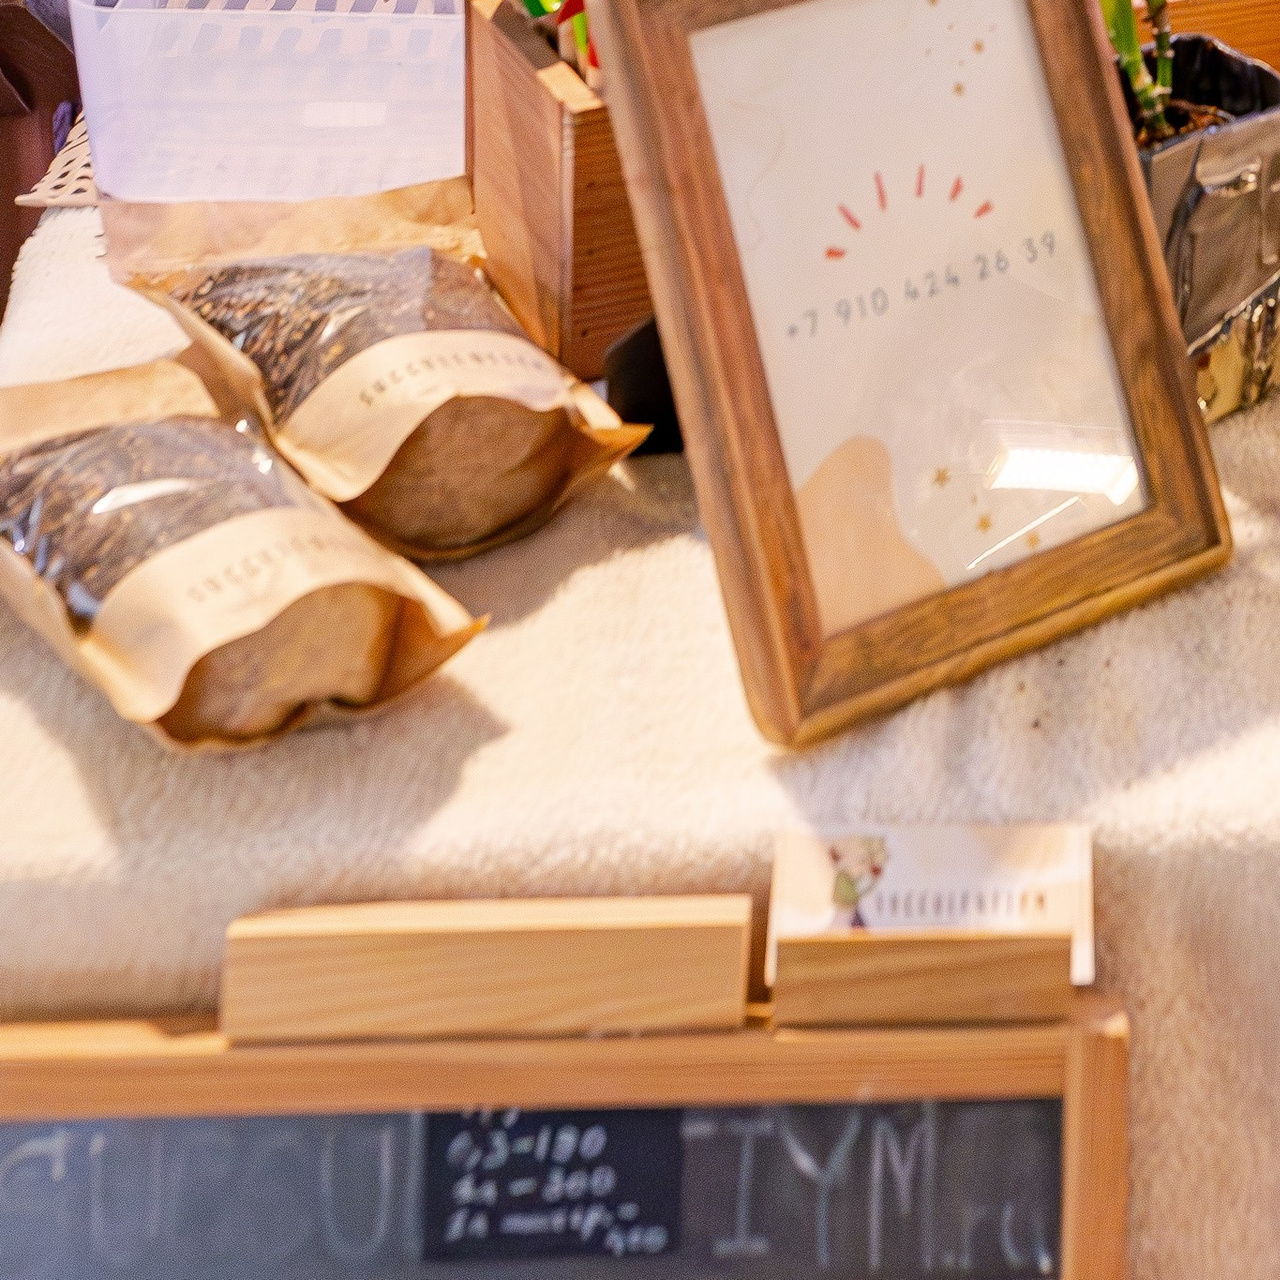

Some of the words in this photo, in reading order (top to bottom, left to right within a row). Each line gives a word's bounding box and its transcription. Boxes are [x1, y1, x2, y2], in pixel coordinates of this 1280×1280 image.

[835, 287, 890, 326] 910
[903, 265, 961, 301] 424
[973, 249, 1011, 282] 26
[1023, 230, 1057, 265] 39
